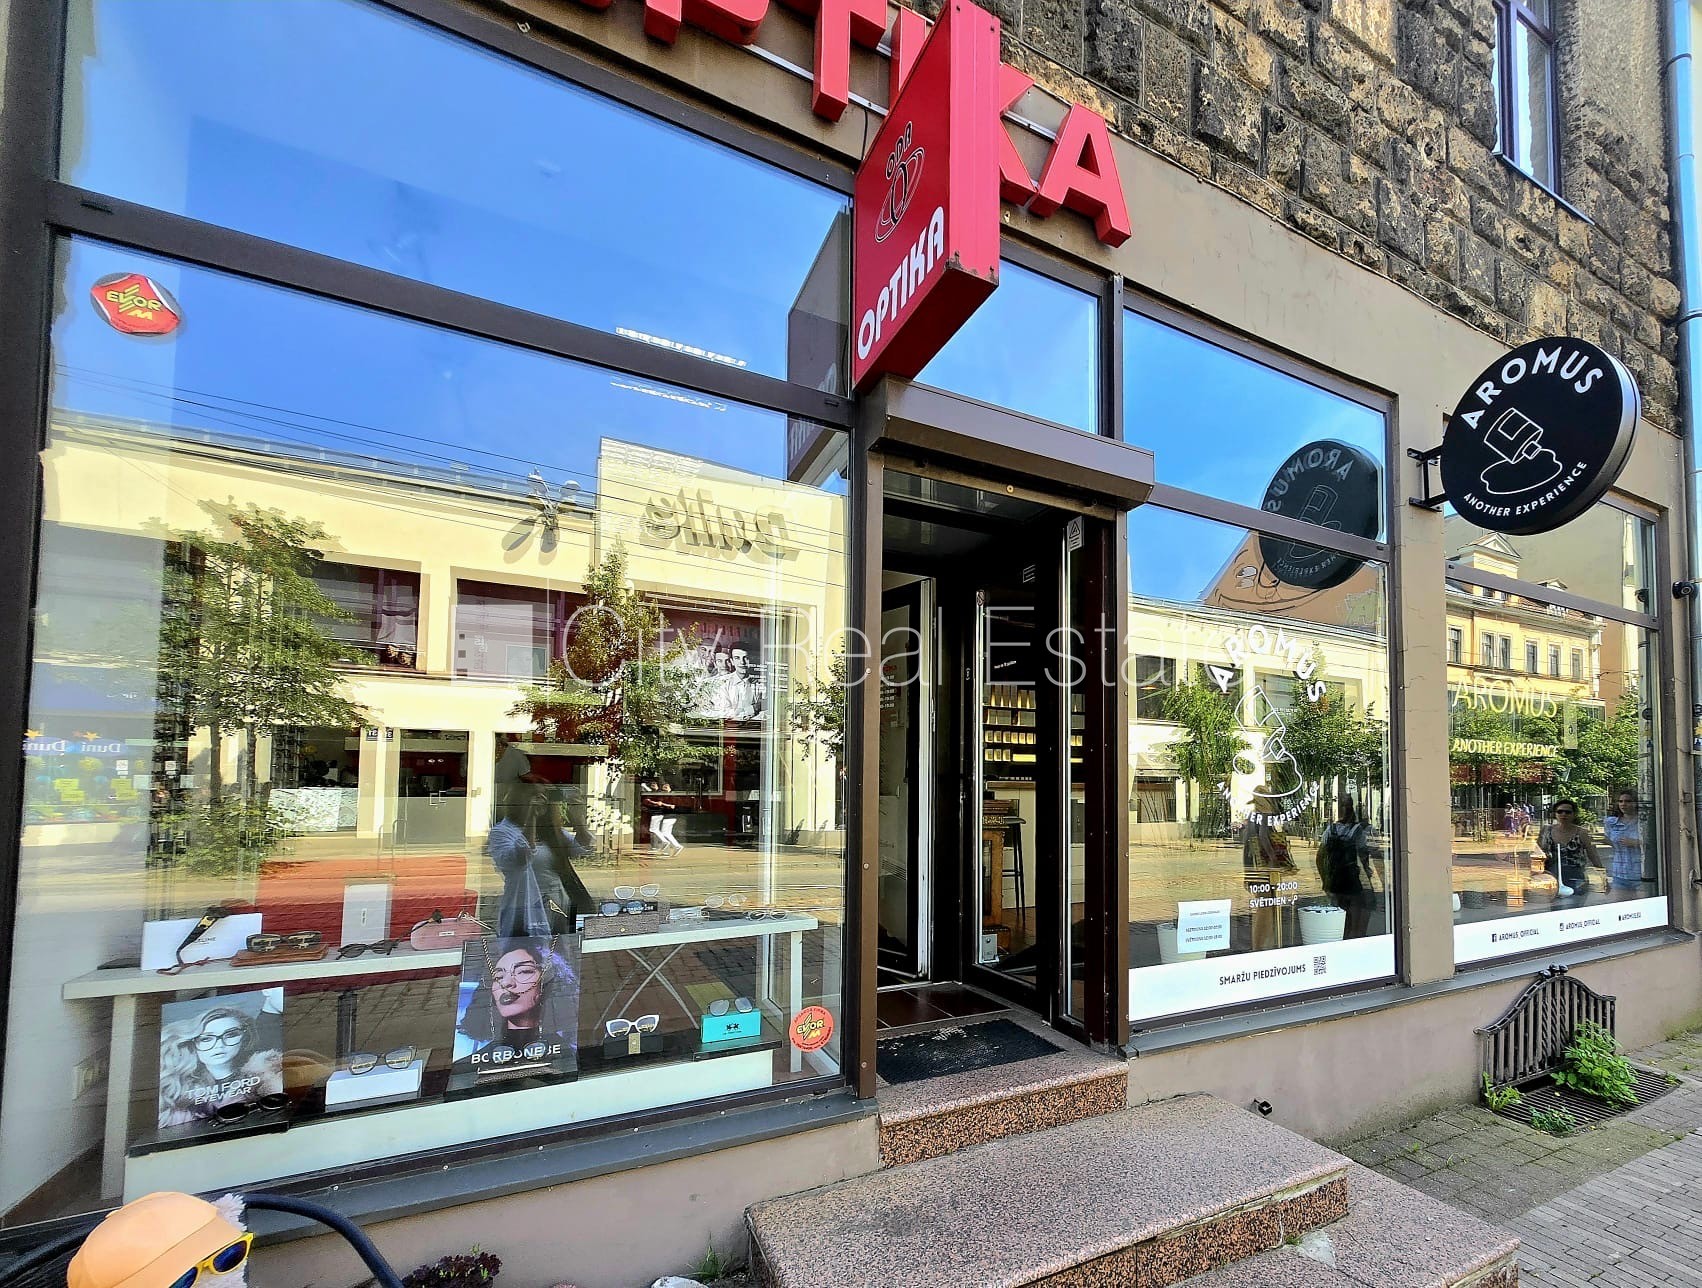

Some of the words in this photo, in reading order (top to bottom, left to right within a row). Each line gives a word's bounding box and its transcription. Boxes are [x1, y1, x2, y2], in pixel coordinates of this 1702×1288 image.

[590, 0, 1132, 248] TIKA
[857, 206, 945, 361] OPTIKA
[1461, 345, 1604, 431] AROMUS
[1463, 492, 1511, 517] ANOTHER
[1515, 461, 1588, 516] EXPERIENCE
[1208, 623, 1328, 703] AROMUS
[1451, 678, 1559, 718] AROMUS
[1450, 738, 1502, 755] ANOTHER
[1503, 741, 1560, 758] EXPERIENCE
[1216, 781, 1263, 825] ANHER
[1267, 780, 1321, 827] EXPERIENCE
[1250, 884, 1270, 894] 10:00
[1276, 882, 1298, 891] 20:00
[1219, 971, 1251, 985] SMARŽU
[194, 1086, 252, 1105] EYEWEAR
[221, 1076, 260, 1092] FORD
